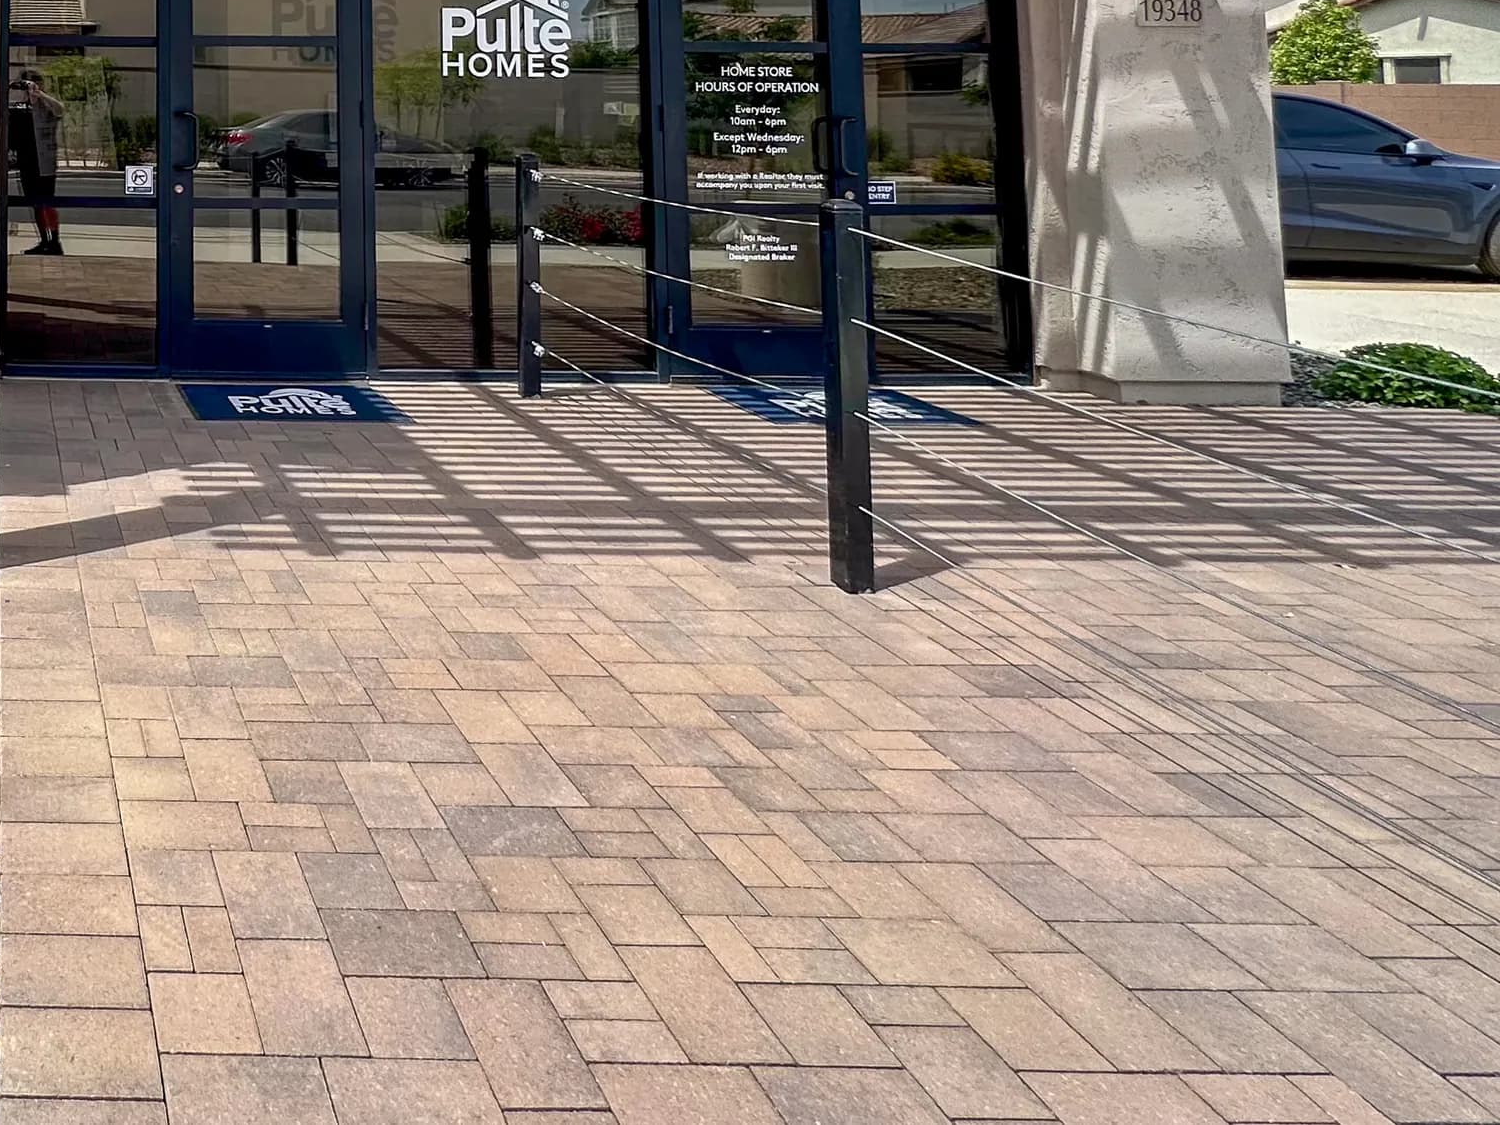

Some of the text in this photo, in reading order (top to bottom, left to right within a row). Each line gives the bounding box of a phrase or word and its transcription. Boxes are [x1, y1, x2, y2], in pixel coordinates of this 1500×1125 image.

[1139, 0, 1202, 22] 19348
[441, 2, 573, 53] Pulte
[441, 53, 571, 78] HOMES
[720, 66, 793, 77] HOME STORE
[695, 82, 820, 93] HOURS OF OPERATION
[735, 104, 781, 115] Everyday:
[730, 117, 756, 126] 10am
[765, 117, 787, 128] 6pm
[713, 132, 805, 144] Except Wednesday:
[731, 144, 757, 155] 12pm
[765, 145, 788, 155] 6pm
[725, 244, 751, 252] Robert
[728, 253, 796, 262] Designated Broker
